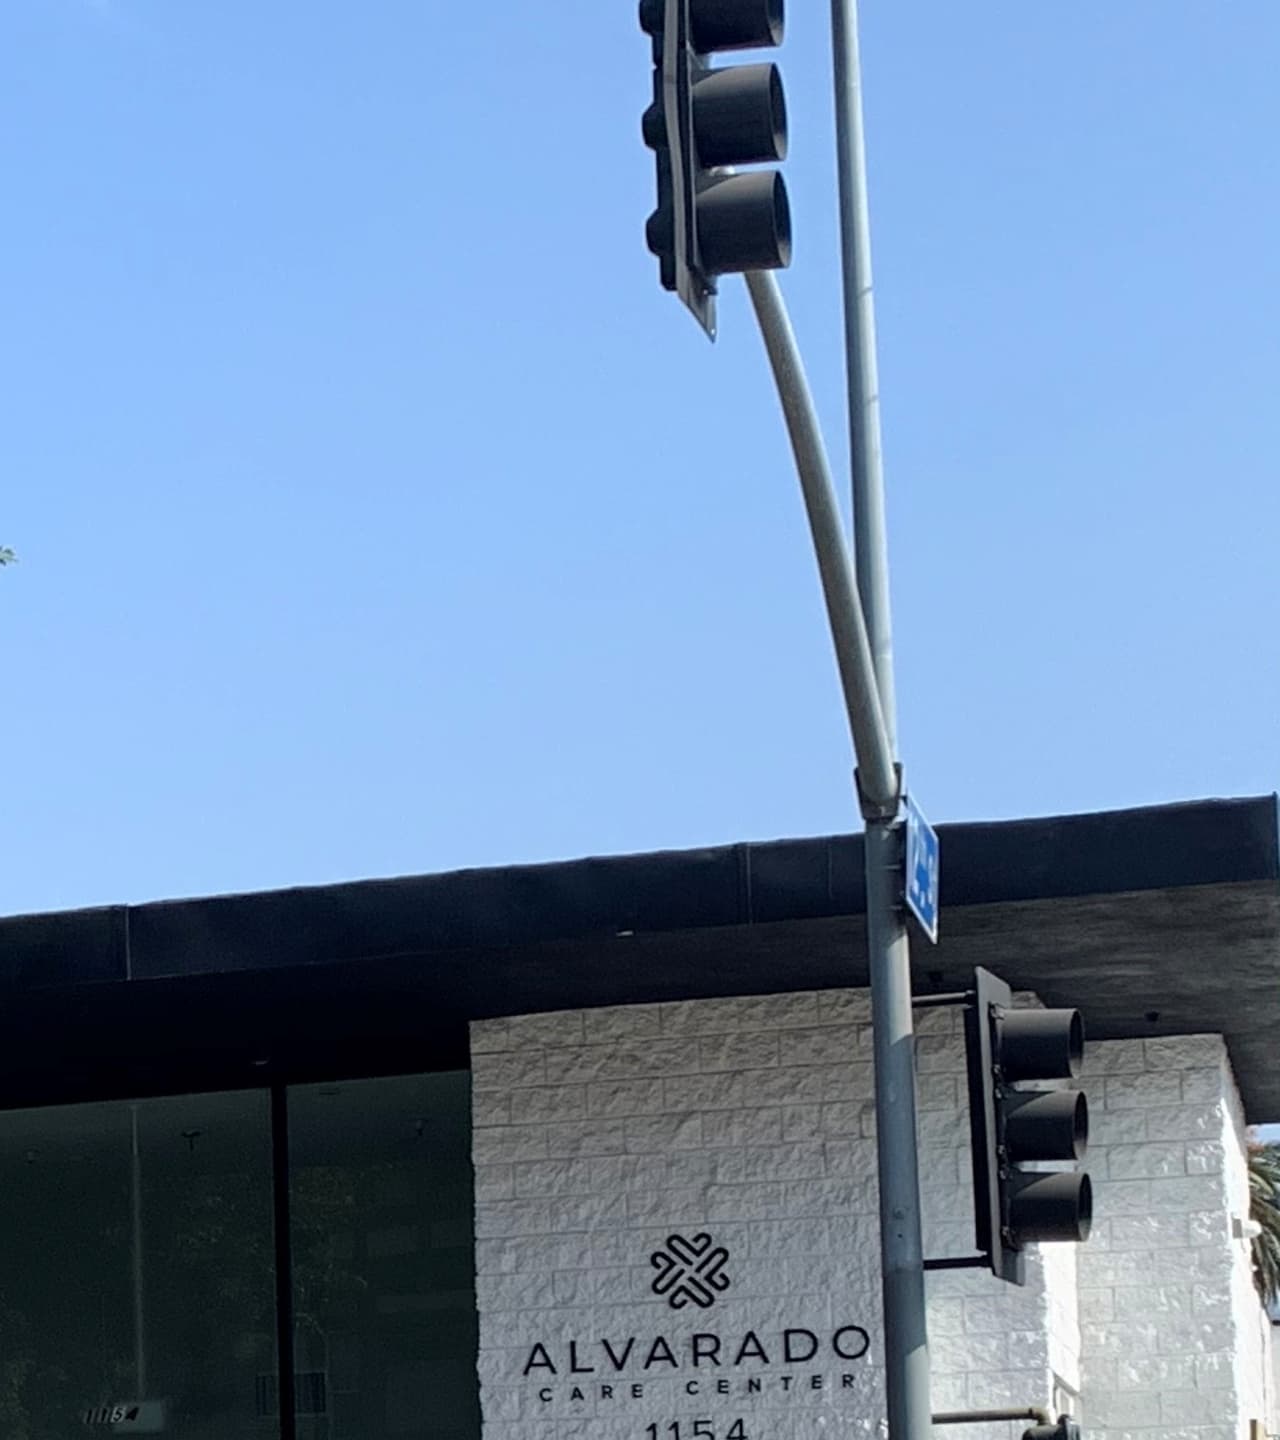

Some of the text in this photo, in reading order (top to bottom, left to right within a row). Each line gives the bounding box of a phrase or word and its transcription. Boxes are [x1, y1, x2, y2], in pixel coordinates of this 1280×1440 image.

[523, 1325, 870, 1376] ALVARADO
[539, 1373, 856, 1402] CARE CENTER
